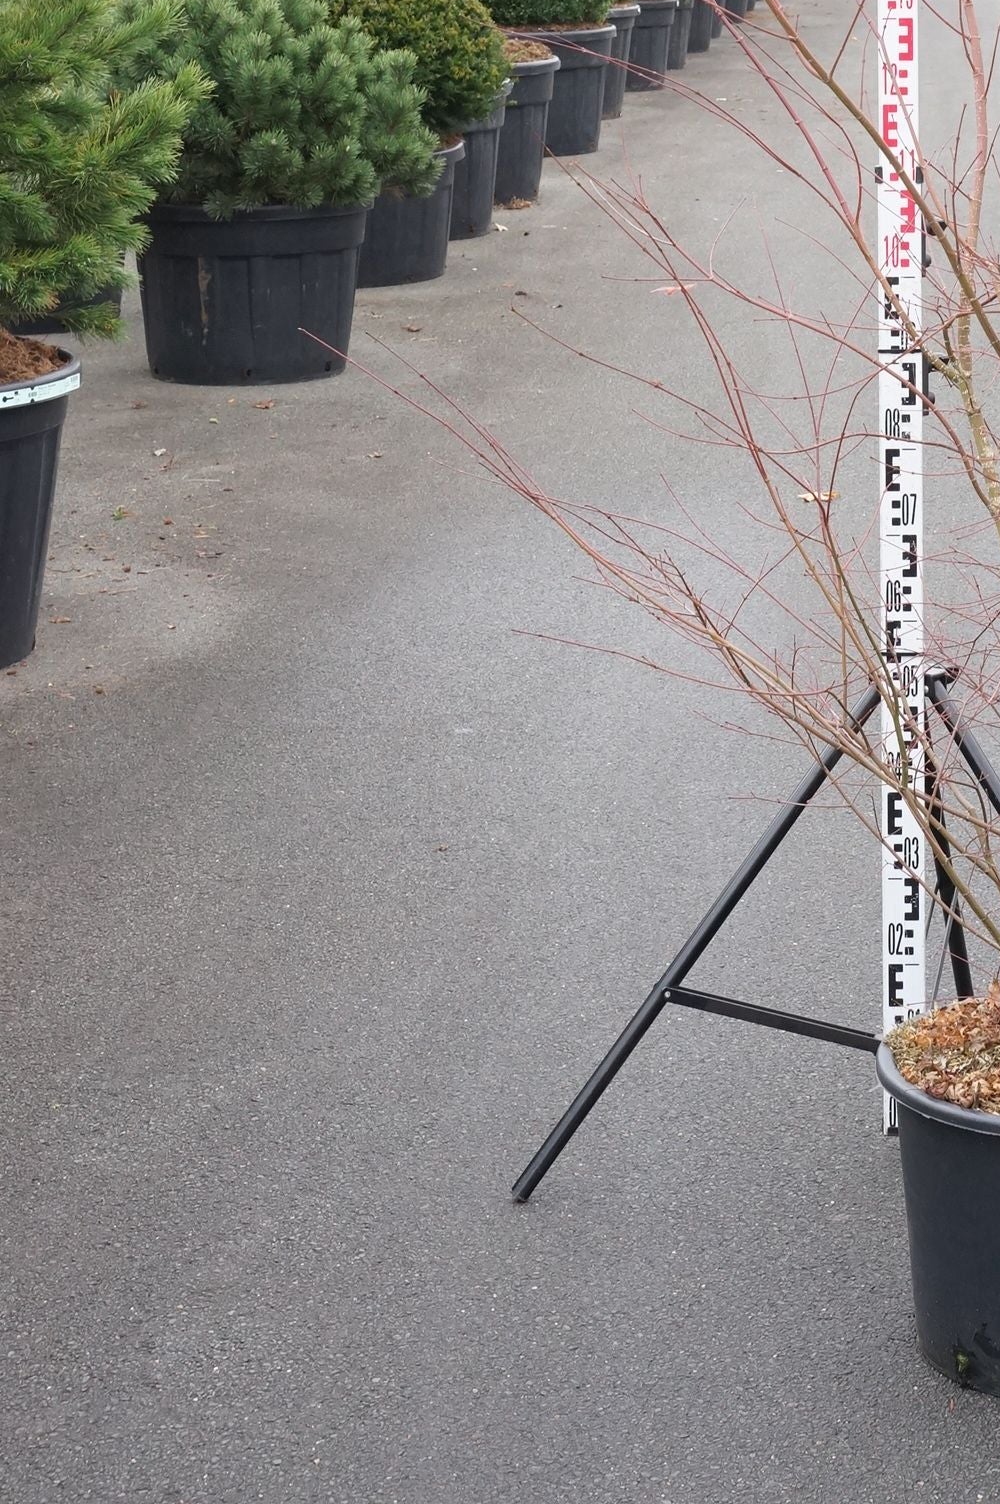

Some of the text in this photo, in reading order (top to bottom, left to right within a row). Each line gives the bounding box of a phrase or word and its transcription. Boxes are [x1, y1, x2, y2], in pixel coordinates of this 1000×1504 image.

[883, 63, 897, 95] 12
[899, 150, 915, 182] 11
[884, 235, 899, 267] 10
[885, 409, 900, 440] 08
[902, 494, 916, 526] 07
[886, 581, 901, 612] 06
[903, 666, 918, 697] 05
[904, 838, 919, 869] 03
[888, 924, 903, 955] 02
